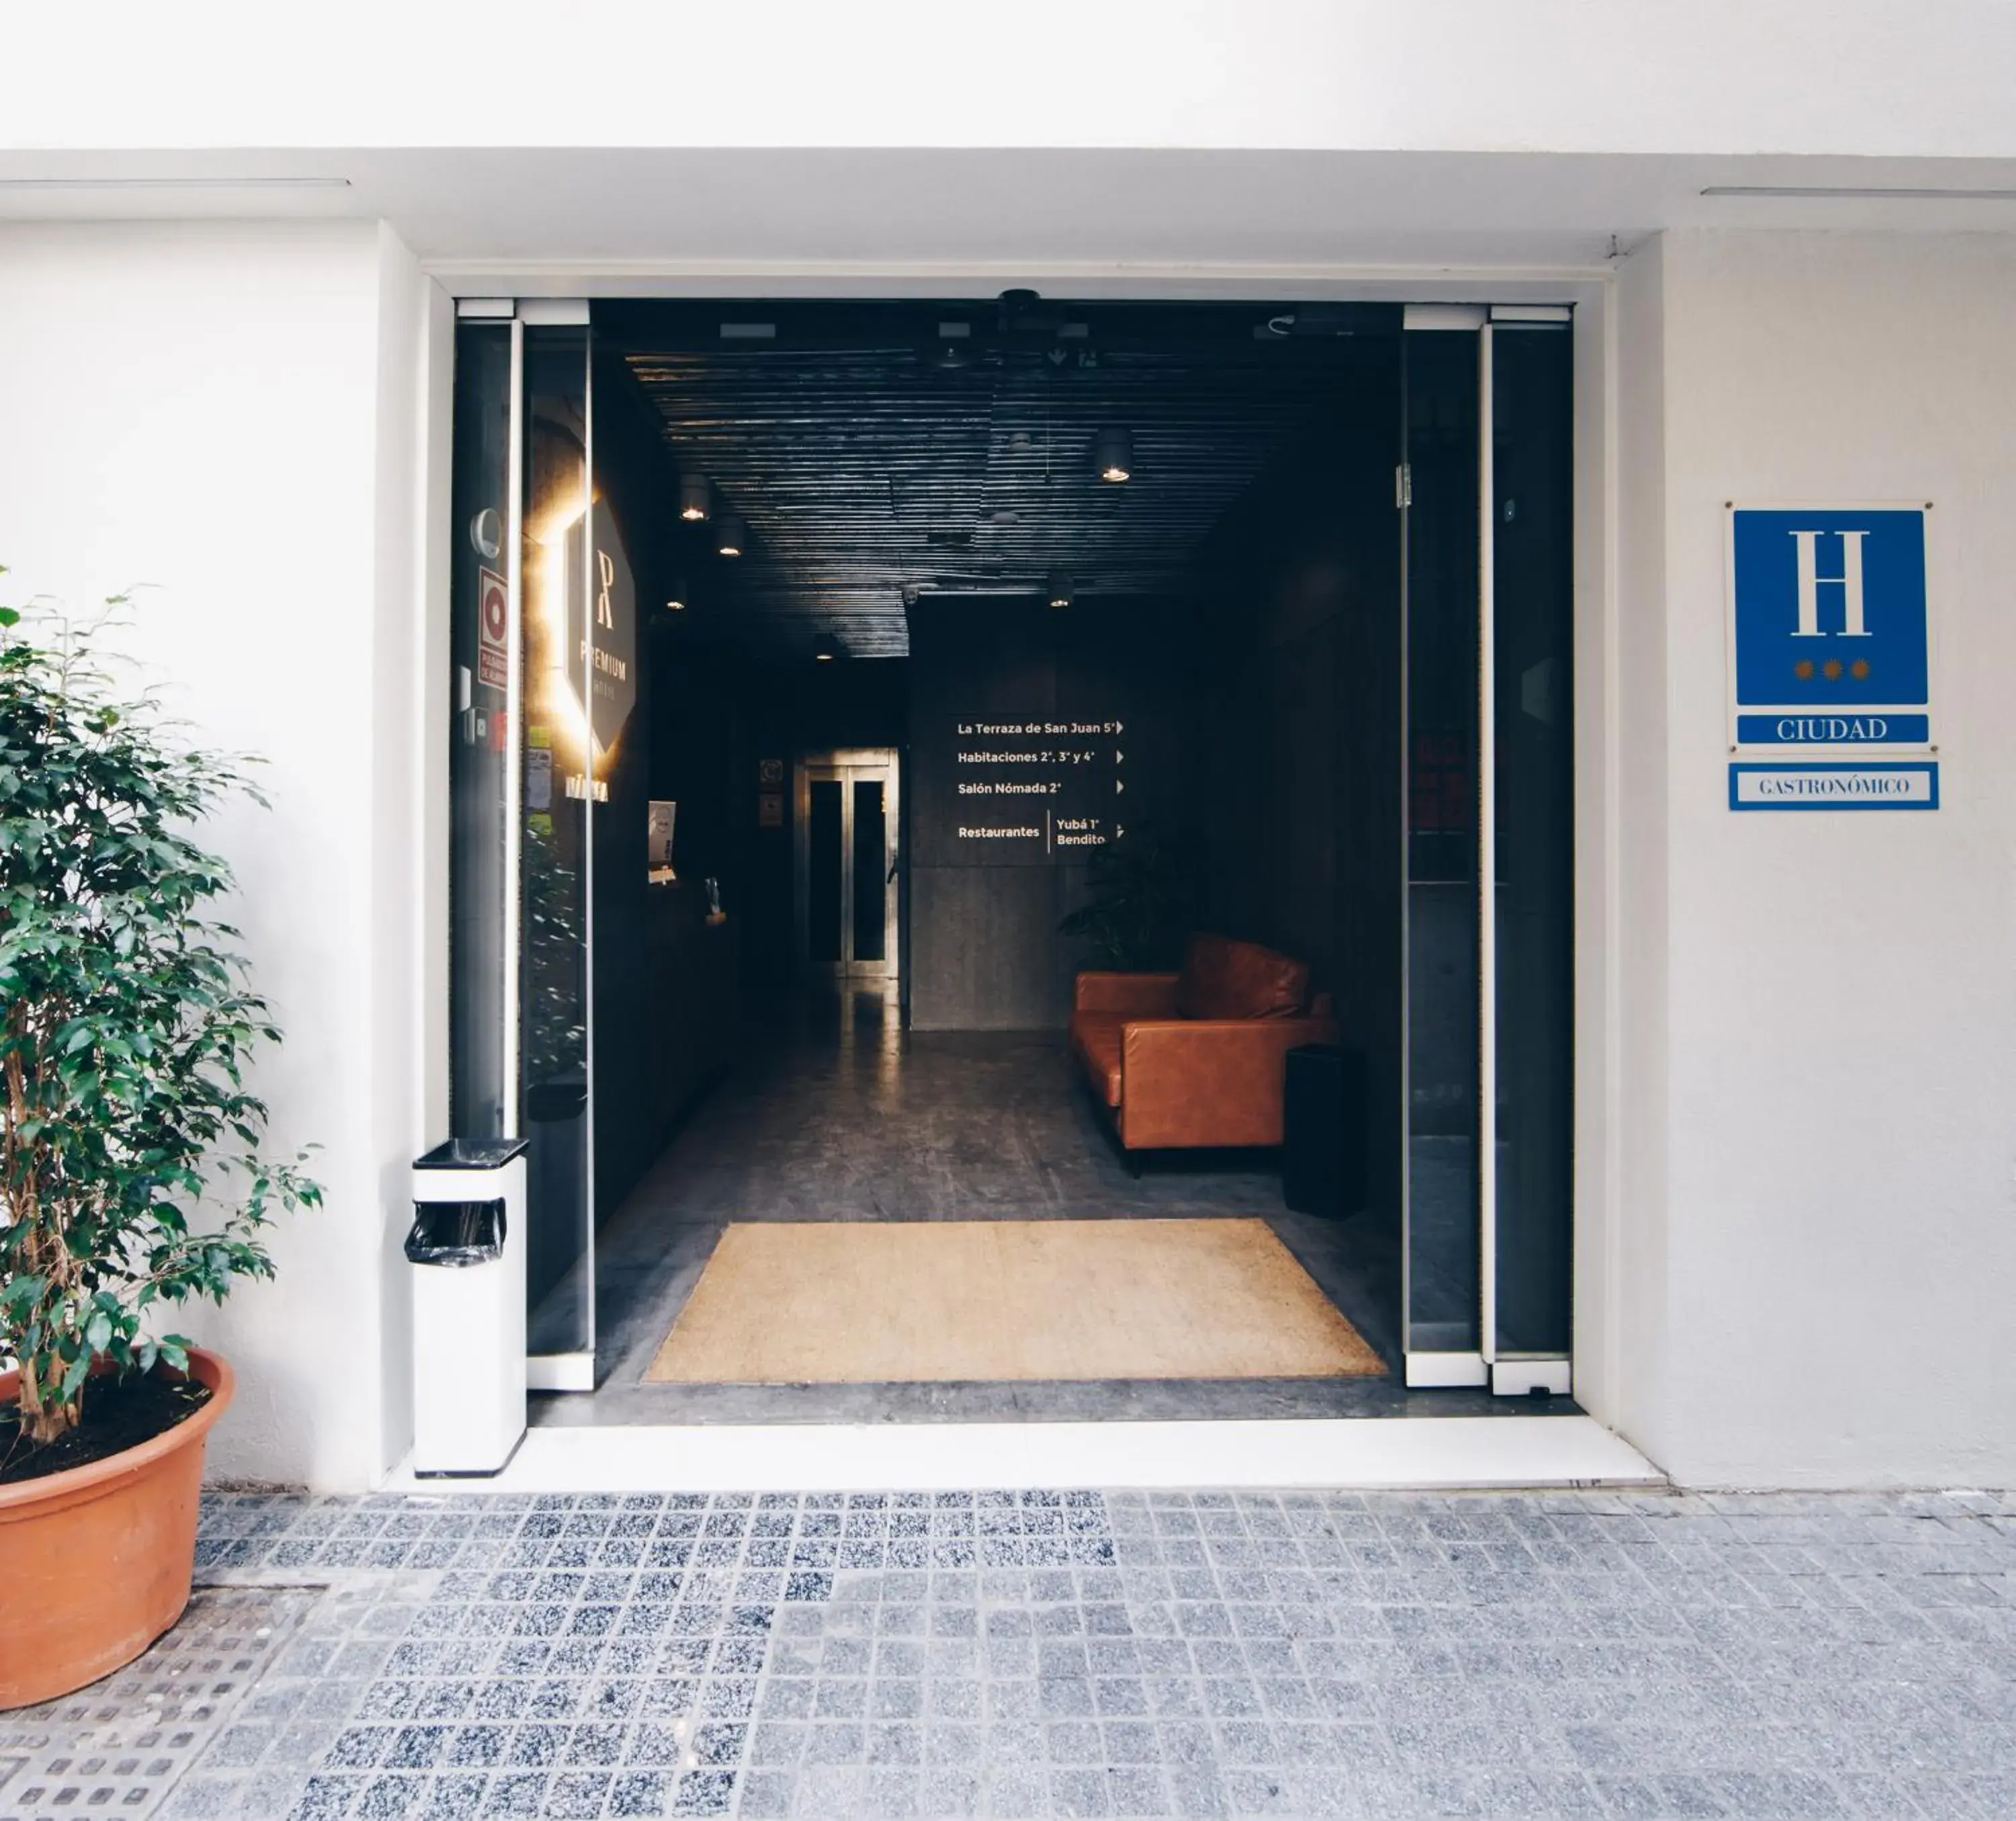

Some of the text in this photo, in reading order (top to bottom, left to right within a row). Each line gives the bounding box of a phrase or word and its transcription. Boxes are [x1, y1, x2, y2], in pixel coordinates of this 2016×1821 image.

[1788, 531, 1872, 636] H
[958, 724, 972, 734] La
[975, 723, 1022, 734] Terraza
[1025, 722, 1042, 734] de
[1044, 722, 1068, 734] San
[1070, 722, 1101, 733] Juan
[1777, 718, 1888, 740] CIUDAD
[958, 751, 1038, 763] Habitaciones
[1073, 753, 1081, 764] y
[958, 782, 993, 794] Salón
[995, 782, 1047, 794] Nómada
[1759, 773, 1910, 795] GASTRONÓMICO
[1056, 818, 1088, 830] Yubá
[958, 826, 1040, 839] Restaurantes
[1057, 833, 1105, 845] Bendito
